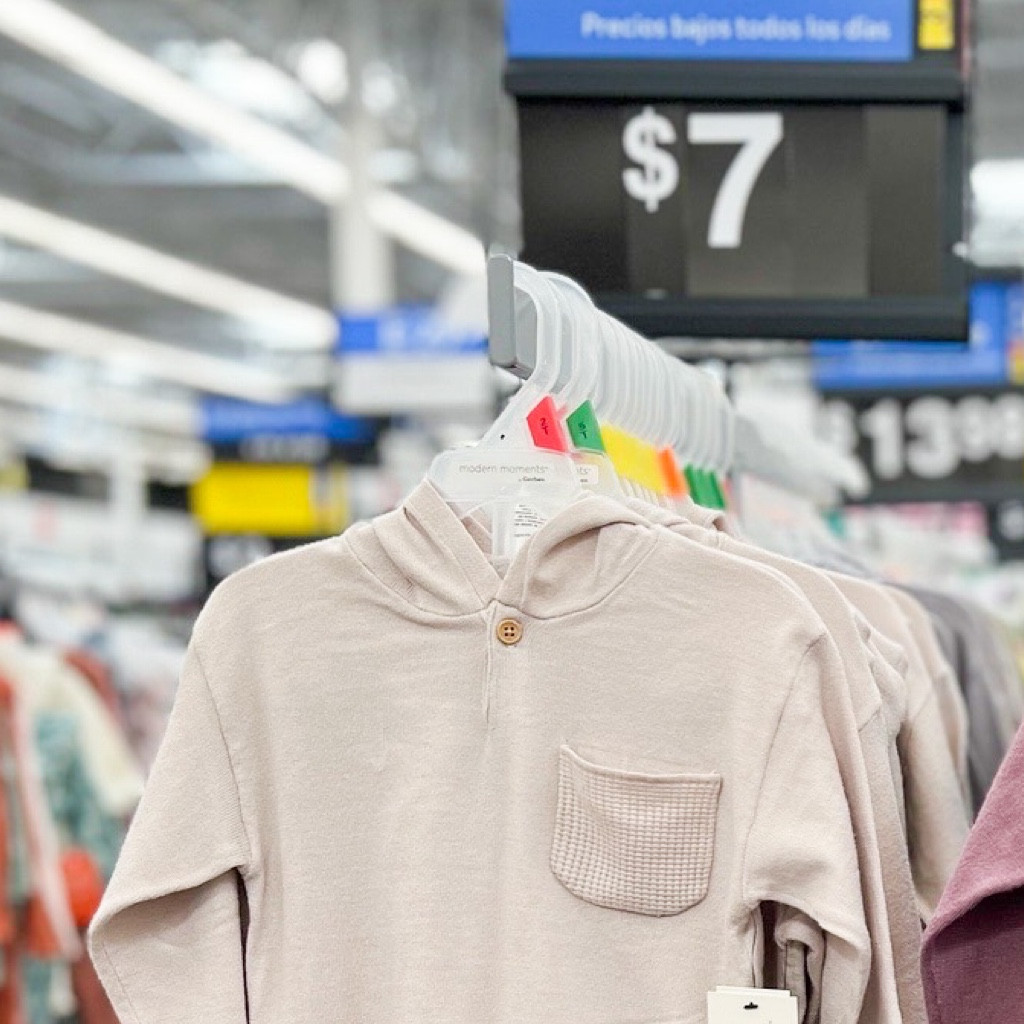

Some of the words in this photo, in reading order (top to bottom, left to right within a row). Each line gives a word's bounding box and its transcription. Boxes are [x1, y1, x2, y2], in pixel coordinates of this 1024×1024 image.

[581, 11, 667, 38] Precios
[670, 13, 732, 46] bajos
[735, 14, 802, 41] todos
[805, 14, 840, 41] los
[622, 106, 783, 248] $7
[459, 464, 497, 474] modern
